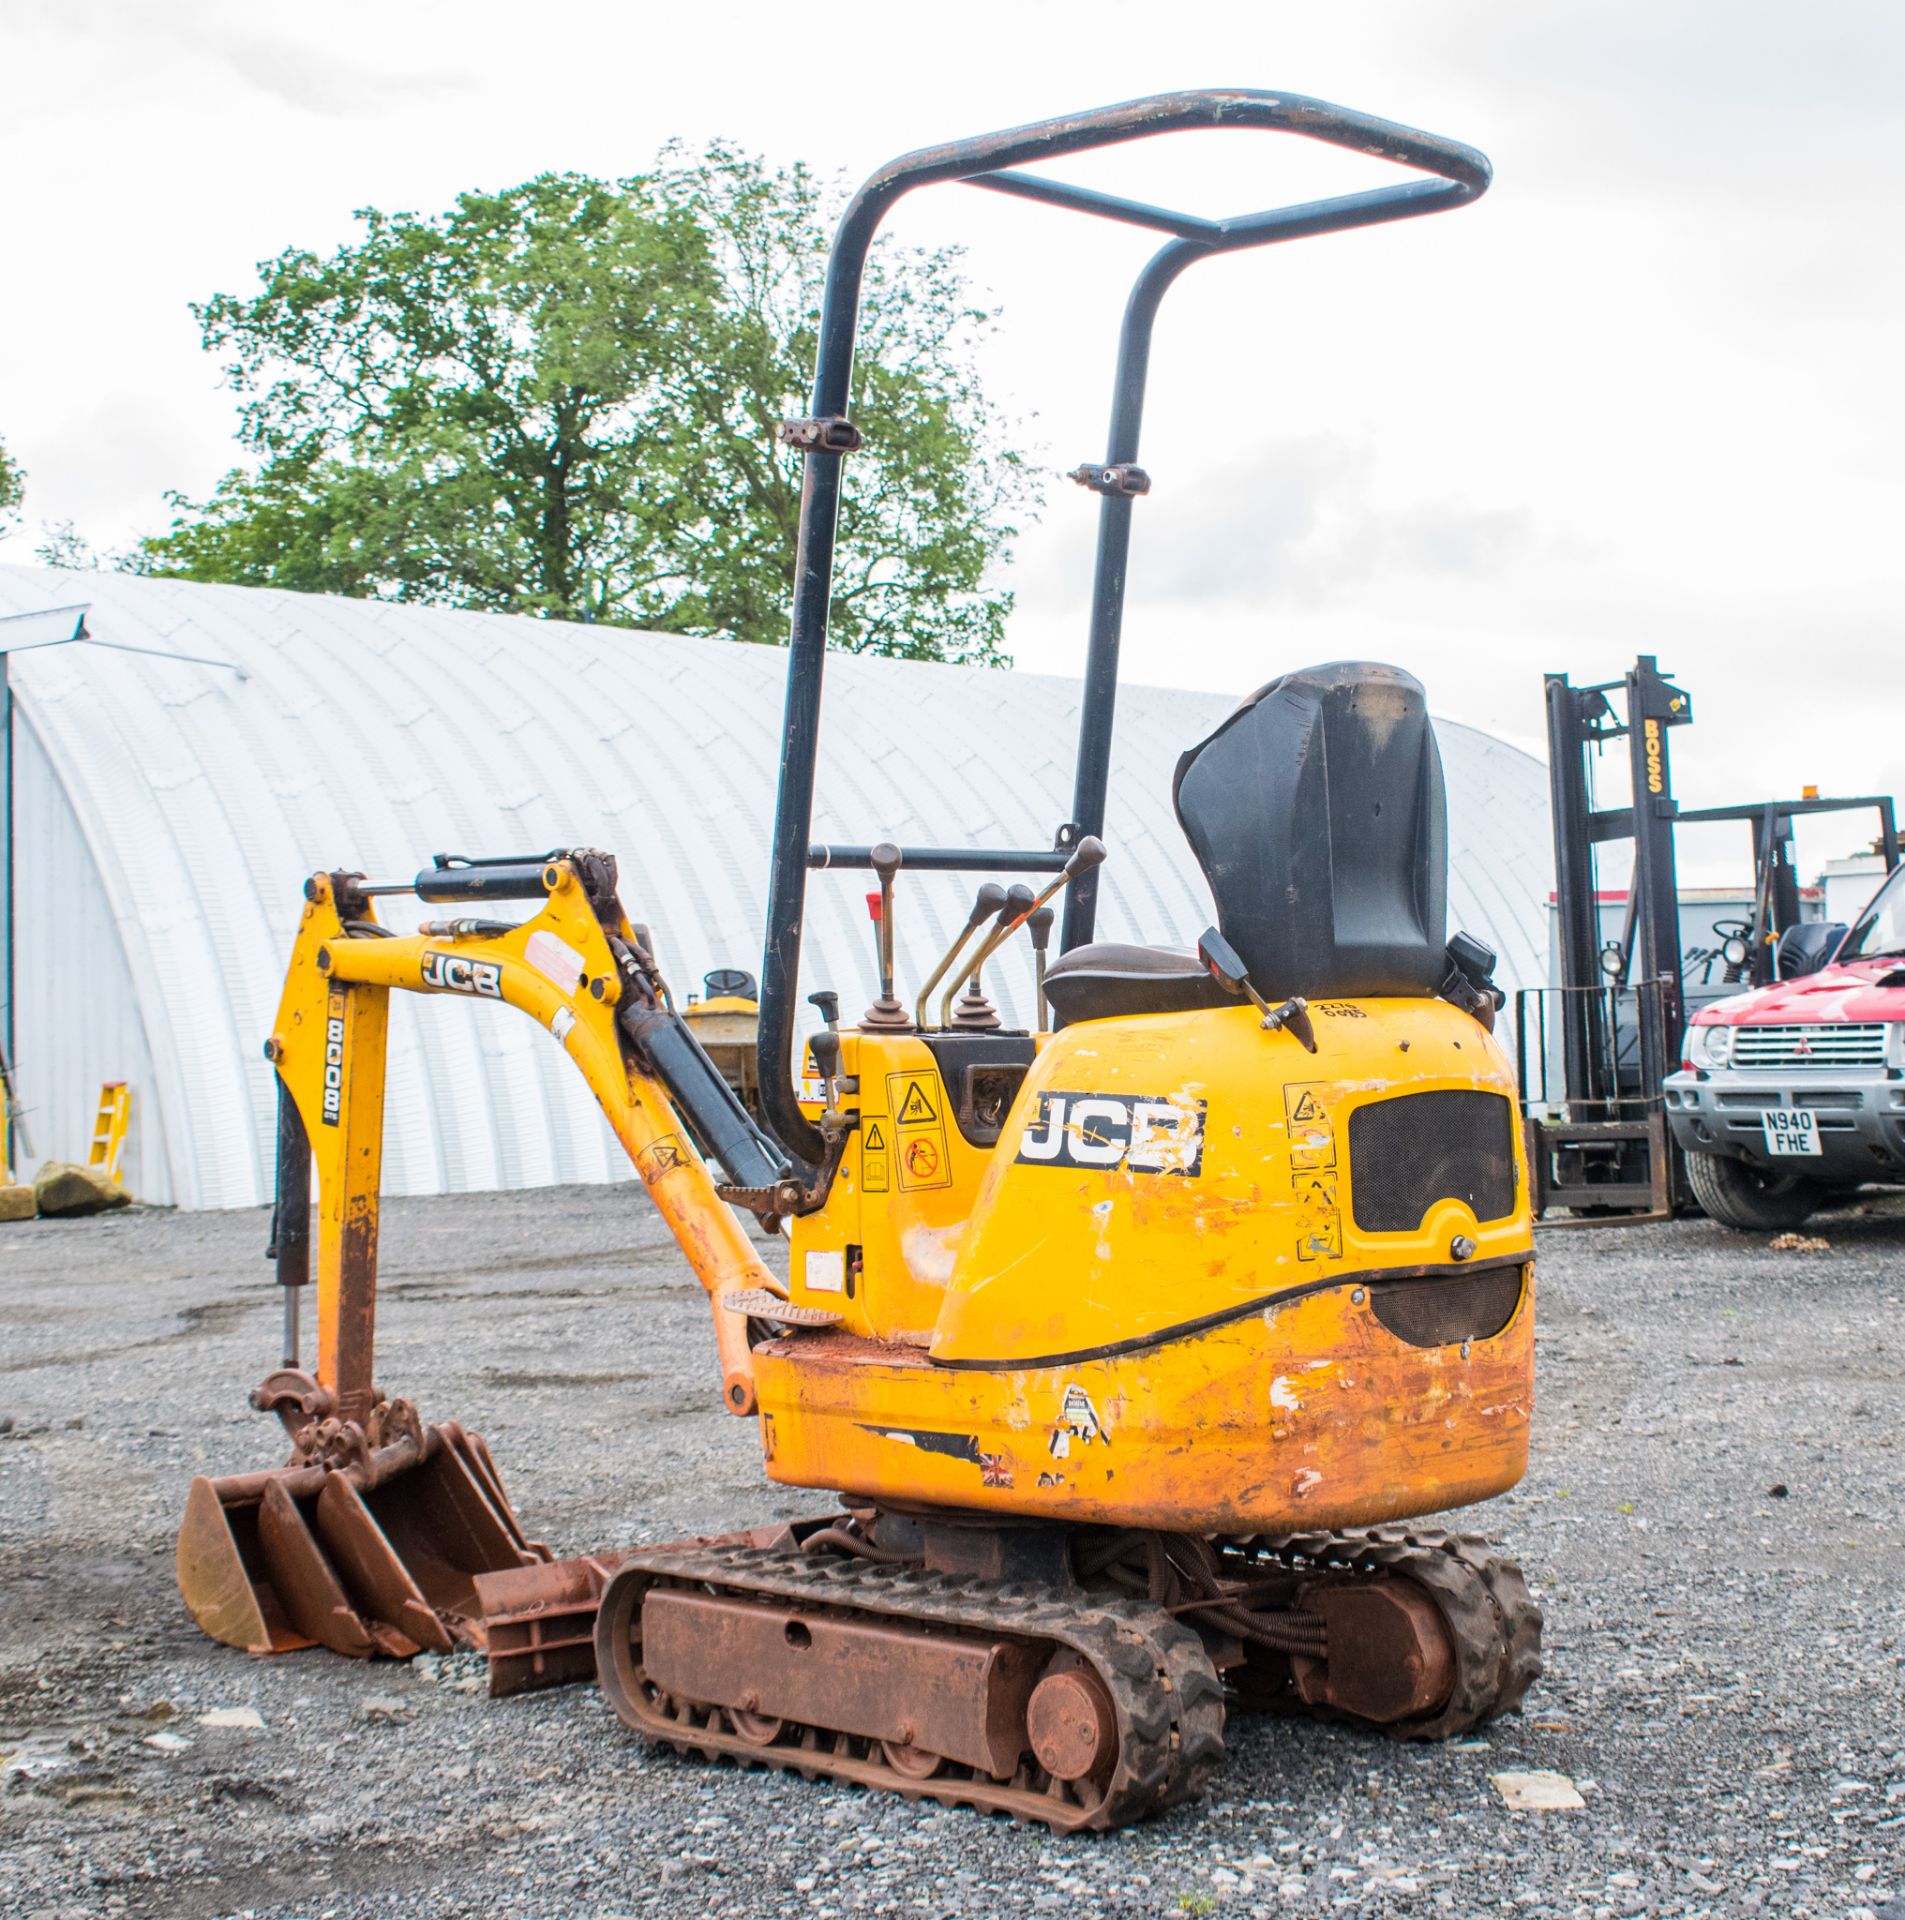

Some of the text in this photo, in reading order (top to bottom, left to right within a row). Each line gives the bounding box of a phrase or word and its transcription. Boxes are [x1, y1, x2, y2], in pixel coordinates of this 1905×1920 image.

[1644, 719, 1662, 793] BOSS
[422, 956, 502, 998] JCB
[324, 1019, 344, 1112] 8008
[1020, 1098, 1199, 1168] JCB
[1765, 1112, 1812, 1130] N940
[1775, 1133, 1811, 1152] FHE
